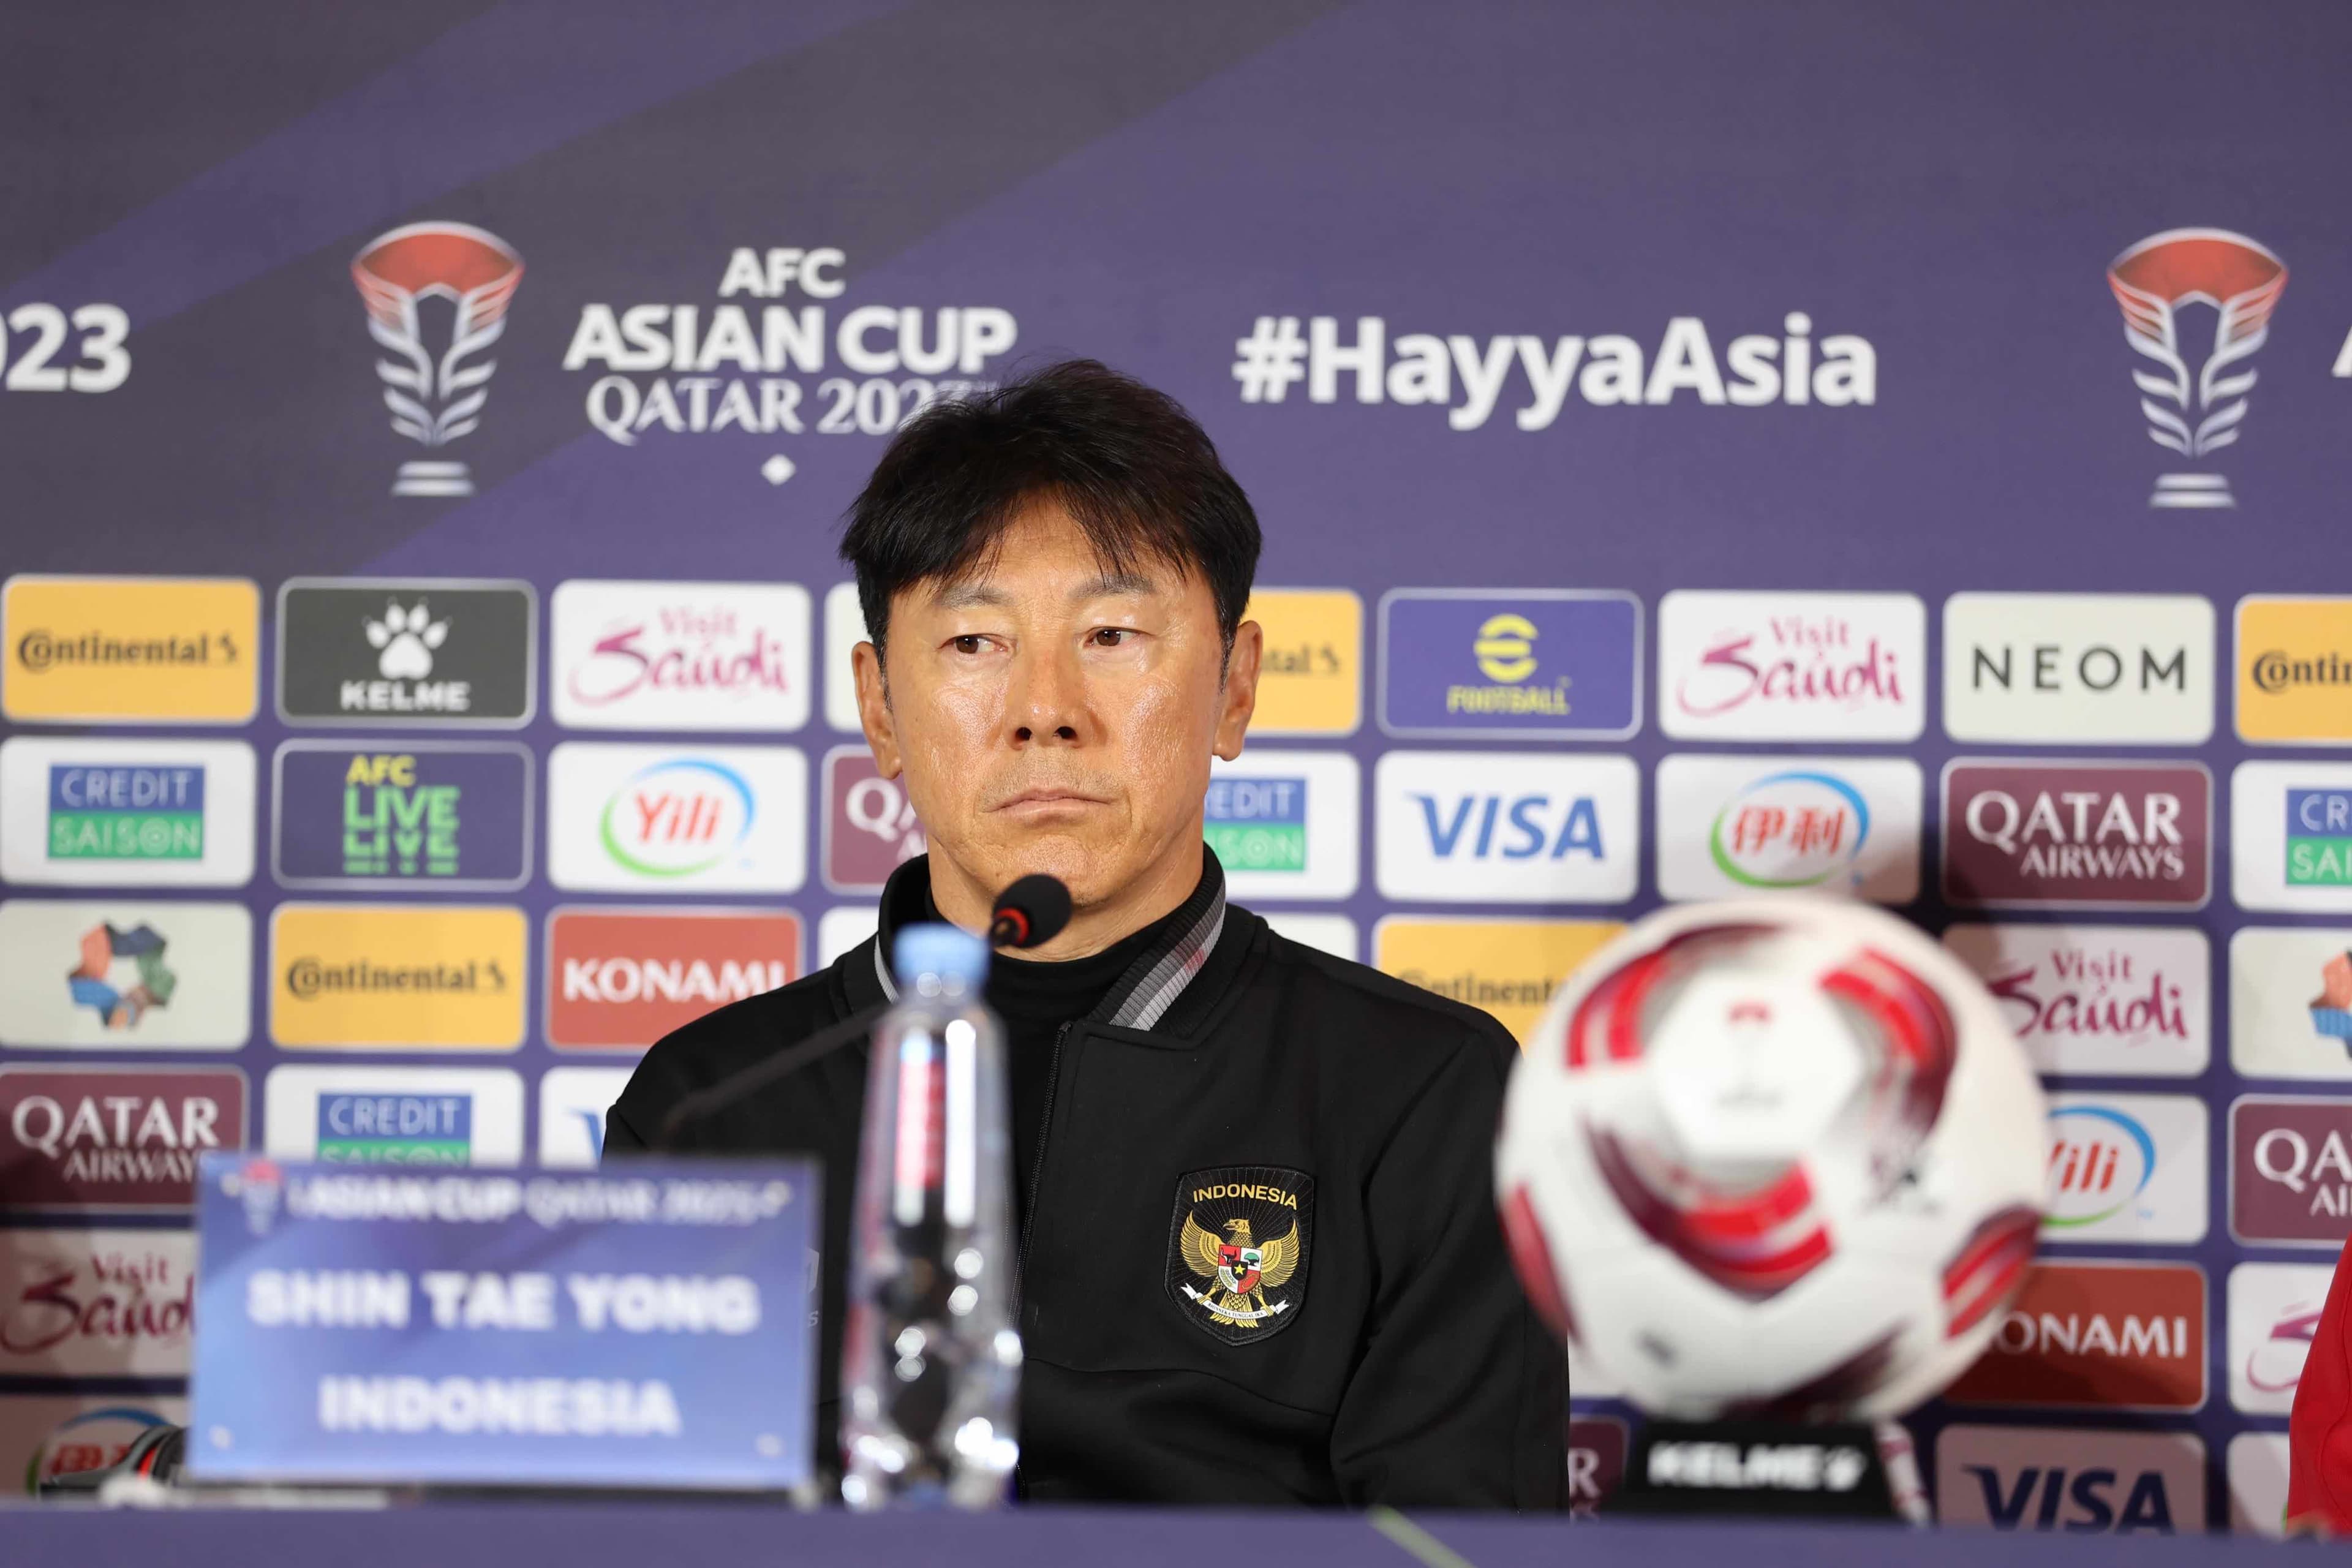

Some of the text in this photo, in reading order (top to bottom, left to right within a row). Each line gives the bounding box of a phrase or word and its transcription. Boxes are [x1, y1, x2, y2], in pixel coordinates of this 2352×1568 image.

[719, 247, 846, 298] AFC
[0, 303, 131, 393] 23
[563, 303, 1018, 375] ASIAN CUP
[1232, 312, 1877, 431] #HayyaAsia
[586, 375, 806, 446] QATAR
[658, 608, 739, 637] Visit
[1768, 617, 1850, 647] Visit
[17, 630, 209, 672] Continental
[568, 625, 789, 706] Saudi
[1972, 644, 2186, 692] NEOM
[340, 680, 471, 712] KELME
[1676, 635, 1904, 718] Saudi
[60, 769, 192, 808] CREDIT
[345, 754, 417, 788] AFC
[343, 785, 461, 829] LIVE
[635, 793, 723, 843] Yili
[1205, 782, 1297, 819] EDIT
[1965, 790, 2182, 855] QATAR
[53, 818, 201, 855] SAISON
[1406, 793, 1605, 859] VISA
[1732, 805, 1845, 856] 伊利
[2020, 845, 2184, 881] AIRWAYS
[287, 957, 477, 1000] Continental
[563, 957, 786, 1003] KONAMI
[2051, 949, 2133, 981] Visit
[1986, 968, 2189, 1041] Saudi
[12, 1095, 220, 1159] QATAR
[328, 1096, 461, 1136] CREDIT
[63, 1151, 199, 1184] AIRWAY
[1193, 1183, 1297, 1210] INDONESIA
[90, 1253, 169, 1284] Visit
[247, 1269, 763, 1335] SHIN TAE YONG
[1998, 1310, 2187, 1359] ONAMI
[316, 1374, 683, 1439] INDONESIA
[1962, 1464, 2176, 1536] VISA
